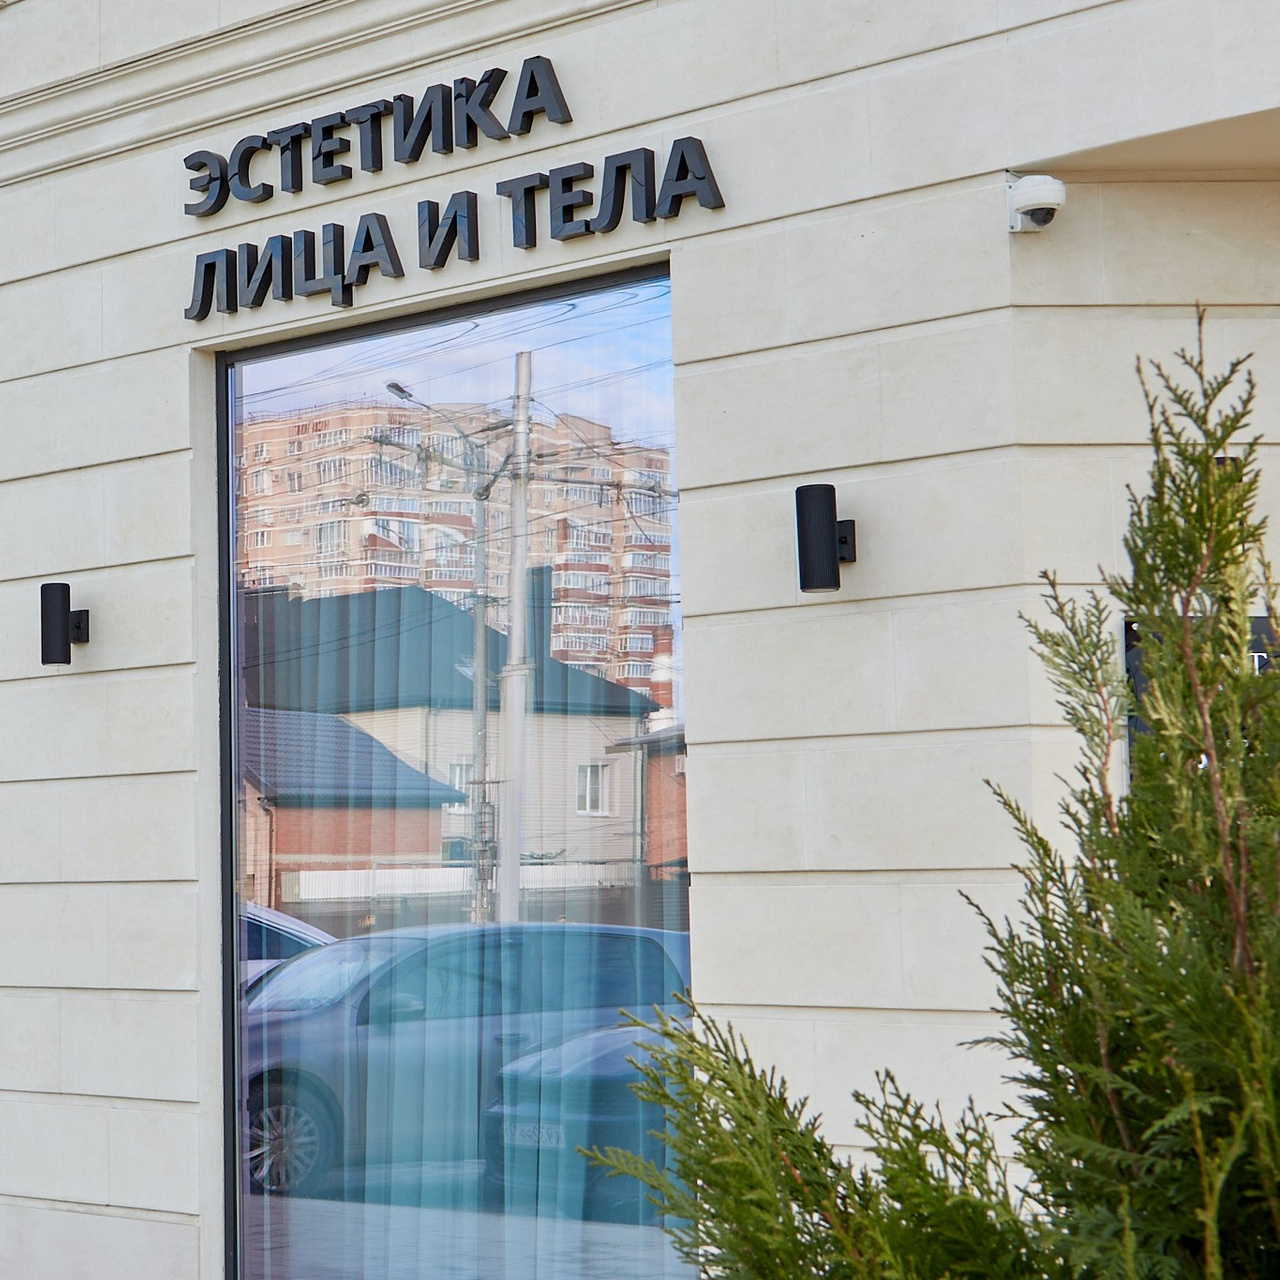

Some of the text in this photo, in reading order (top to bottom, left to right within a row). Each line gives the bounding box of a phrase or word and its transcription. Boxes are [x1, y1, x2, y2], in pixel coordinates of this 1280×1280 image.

[184, 55, 573, 218] ЭСТЕТИКА
[184, 136, 725, 322] ЛИЦА И ТЕЛА
